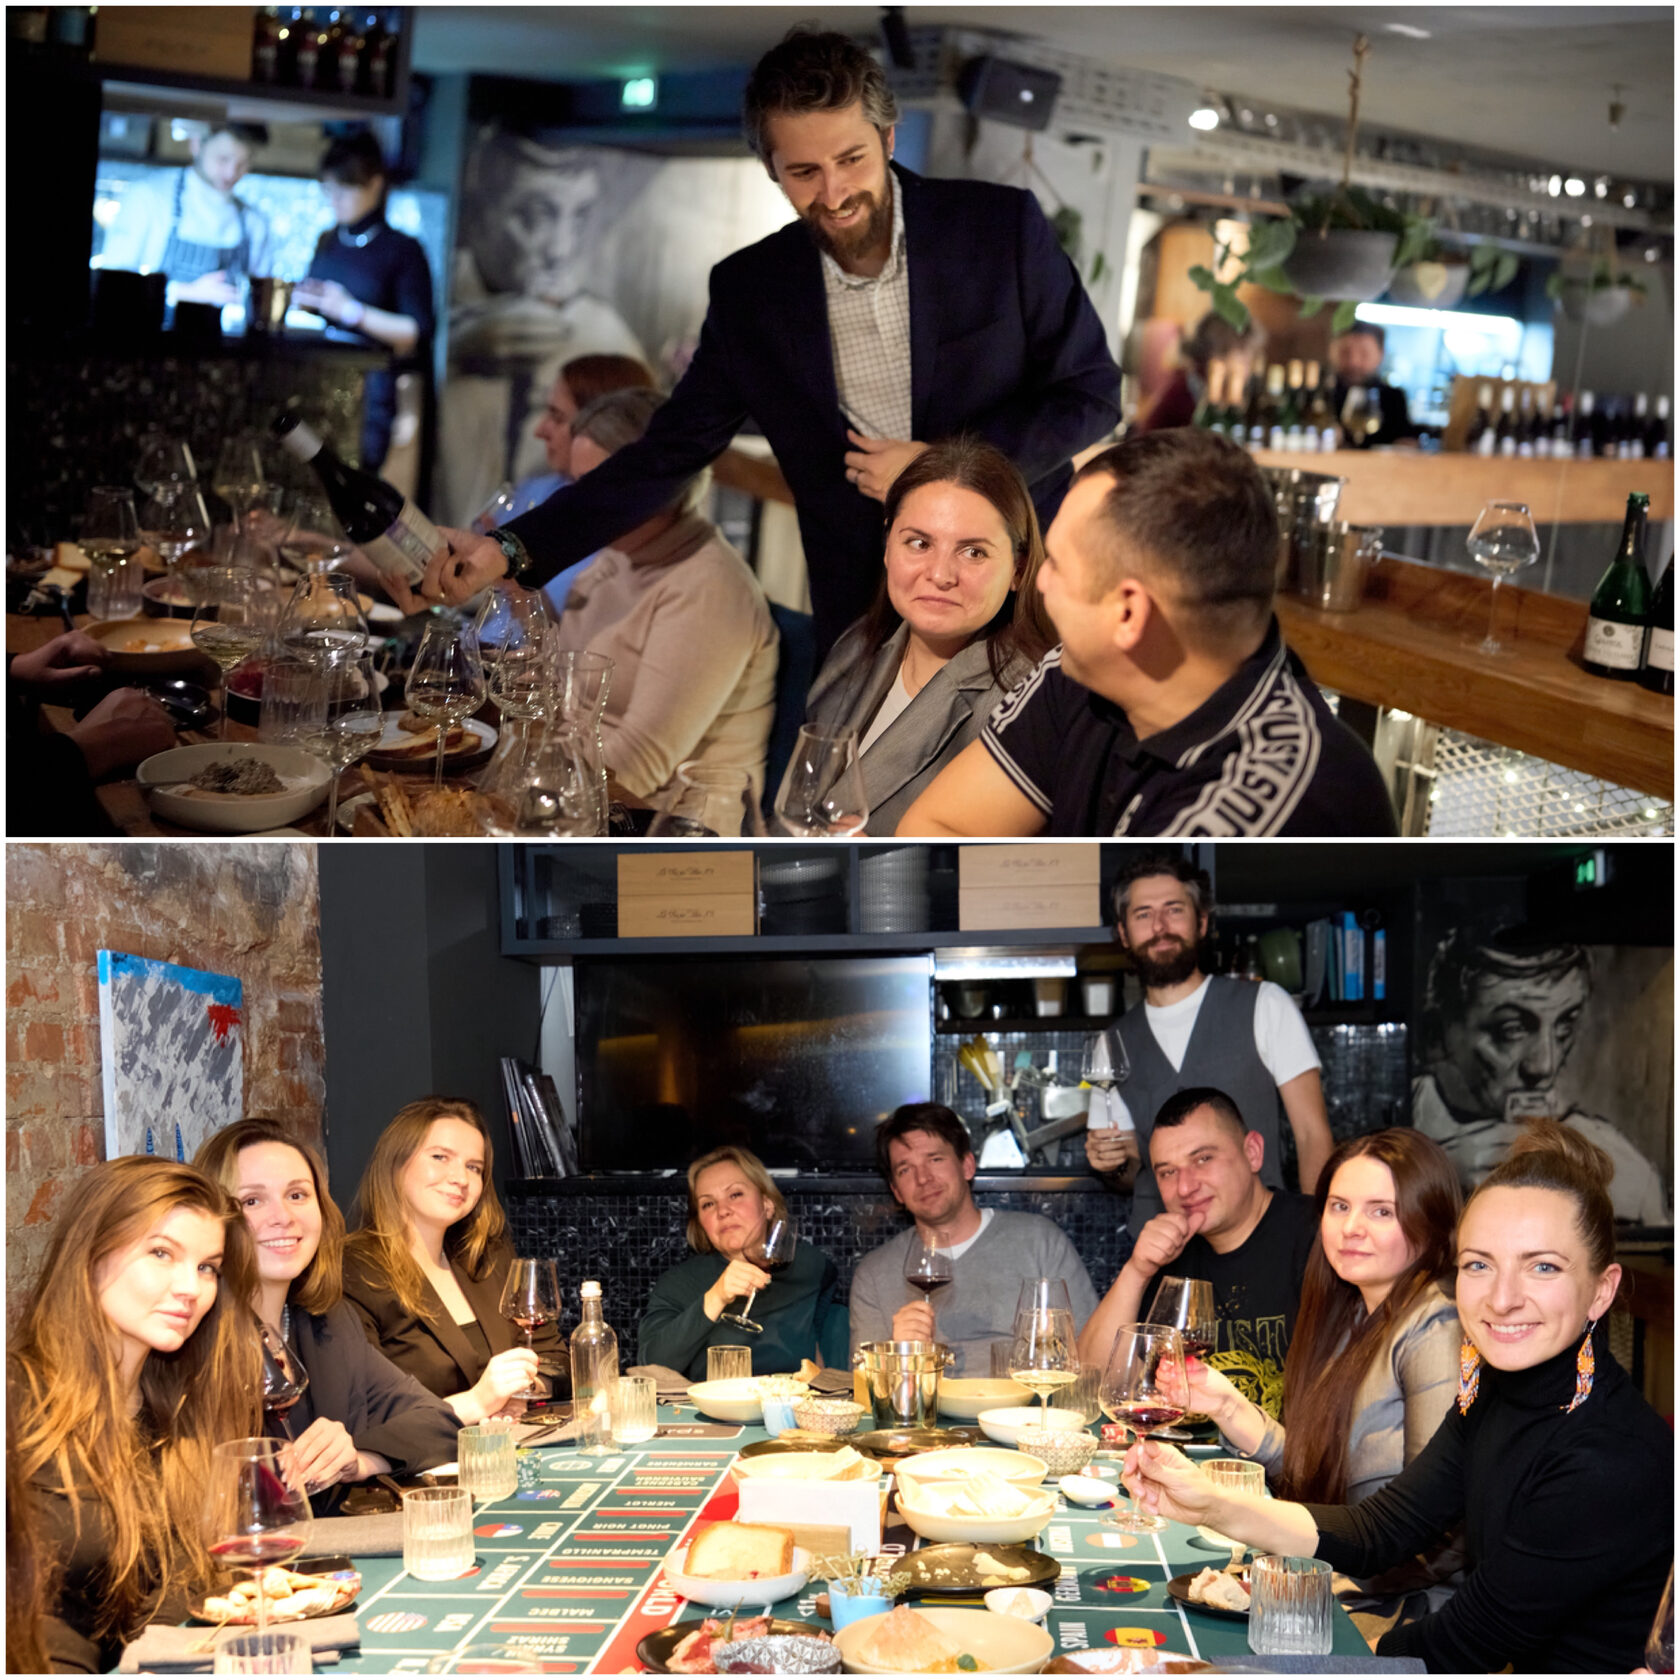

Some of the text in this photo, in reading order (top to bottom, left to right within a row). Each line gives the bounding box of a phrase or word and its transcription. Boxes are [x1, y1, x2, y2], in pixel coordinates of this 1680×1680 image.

[540, 1575, 634, 1584] SANGIOVESE
[527, 1607, 595, 1616] MALBEC
[1058, 1621, 1090, 1649] SPAIN
[505, 1635, 571, 1645] SHIRAZ
